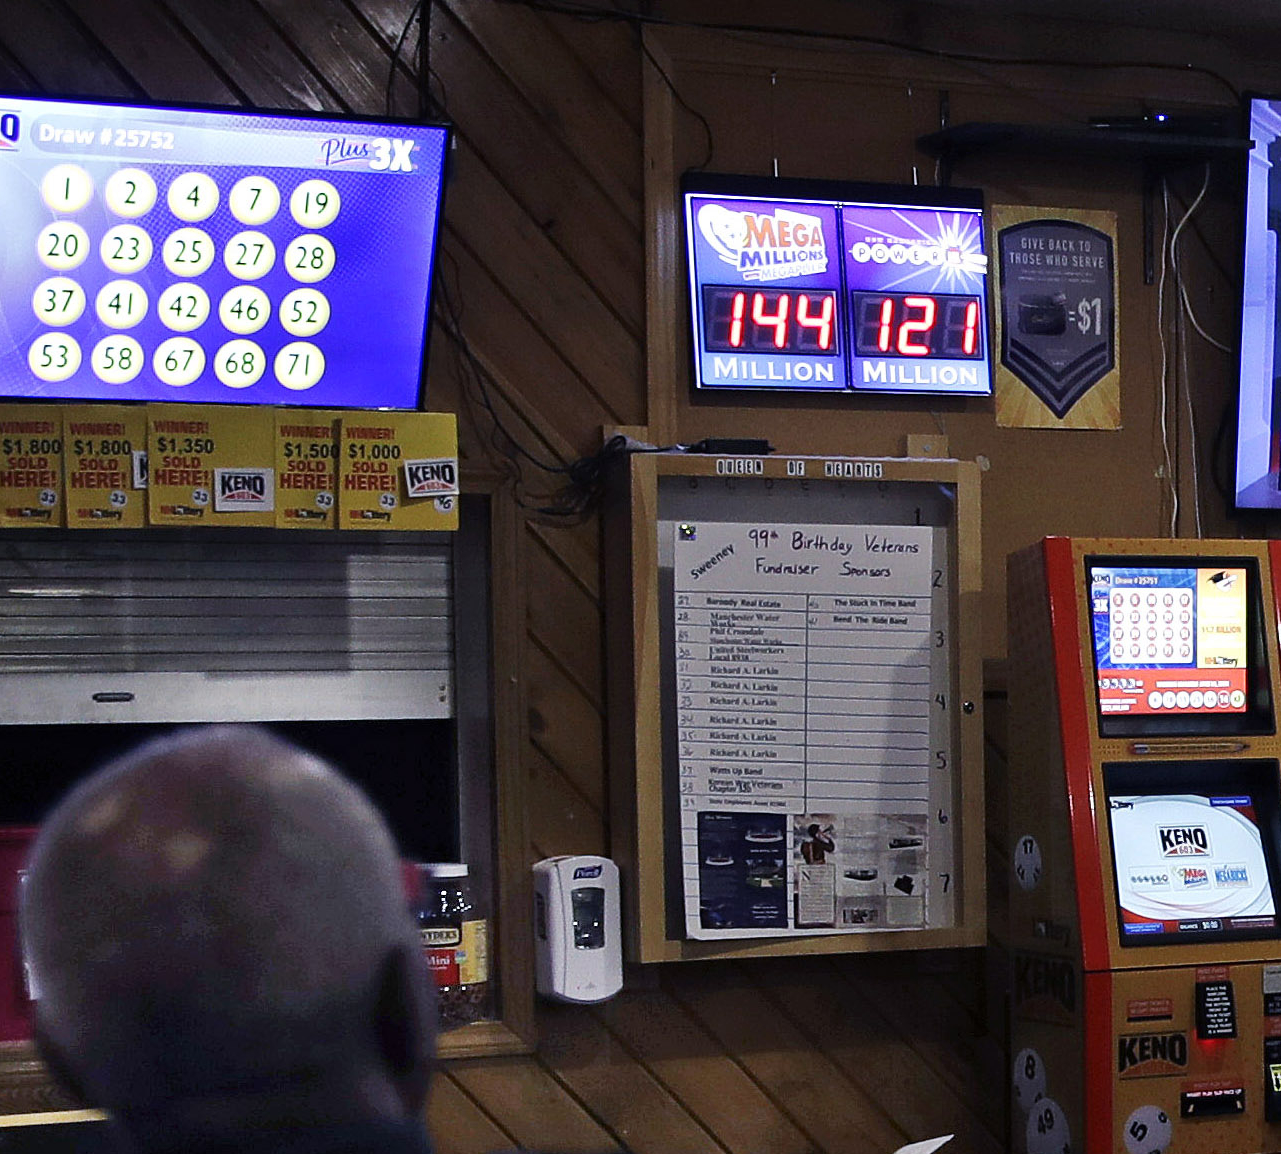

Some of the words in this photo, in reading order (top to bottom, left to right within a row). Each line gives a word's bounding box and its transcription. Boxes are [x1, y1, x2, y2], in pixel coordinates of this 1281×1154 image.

[39, 123, 96, 143] Draw
[99, 127, 175, 150] #25752
[320, 138, 370, 164] Plus
[369, 136, 415, 173] 3X
[62, 177, 70, 202] 1
[123, 180, 137, 205] 2
[185, 184, 201, 208] 4
[248, 187, 262, 211] 7
[304, 190, 328, 215] 19
[743, 214, 823, 249] MEGA
[47, 233, 79, 258] 20
[111, 236, 141, 261] 23
[174, 240, 203, 264] 25
[235, 242, 264, 266] 27
[296, 246, 324, 270] 28
[1021, 237, 1045, 250] GIVE
[1048, 238, 1075, 252] BACK
[1079, 240, 1091, 252] TO
[739, 249, 824, 270] MILLIONS
[1009, 251, 1042, 266] THOSE
[1045, 254, 1068, 267] WHO
[1072, 255, 1104, 269] SERVE
[45, 289, 74, 313] 37
[108, 292, 134, 315] 41
[169, 295, 198, 319] 42
[230, 298, 259, 321] 46
[291, 301, 318, 324] 52
[729, 291, 834, 350] 144
[877, 295, 978, 356] 121
[40, 345, 69, 368] 53
[102, 347, 132, 371] 58
[163, 350, 193, 373] 67
[225, 352, 254, 376] 68
[287, 354, 310, 377] 71
[713, 356, 834, 383] MILLION
[863, 360, 978, 385] MILLION
[70, 422, 126, 436] WINNER!
[153, 420, 209, 434] WINNER!
[346, 427, 395, 440] WINNER!
[74, 439, 132, 456] $1,800
[157, 436, 215, 454] $1,350
[349, 443, 401, 460] $1,000
[79, 458, 118, 471] SOLD
[162, 456, 202, 469] SOLD
[352, 462, 388, 473] SOLD
[717, 460, 764, 475] QUEEN
[787, 461, 805, 476] OF
[825, 462, 882, 479] HEARTS
[71, 472, 127, 489] HERE!
[154, 469, 209, 487] HERE!
[220, 474, 265, 496] KENO
[344, 475, 396, 492] HERE!
[408, 464, 456, 489] KENO
[791, 531, 853, 556] Birthday
[865, 533, 919, 554] Veterans
[755, 557, 819, 576] Fundraiser
[839, 561, 891, 577] Sponsors
[1159, 828, 1208, 850] KENO
[1178, 845, 1194, 855] 603
[1119, 1033, 1187, 1072] KENO
[1130, 1121, 1148, 1141] 5
